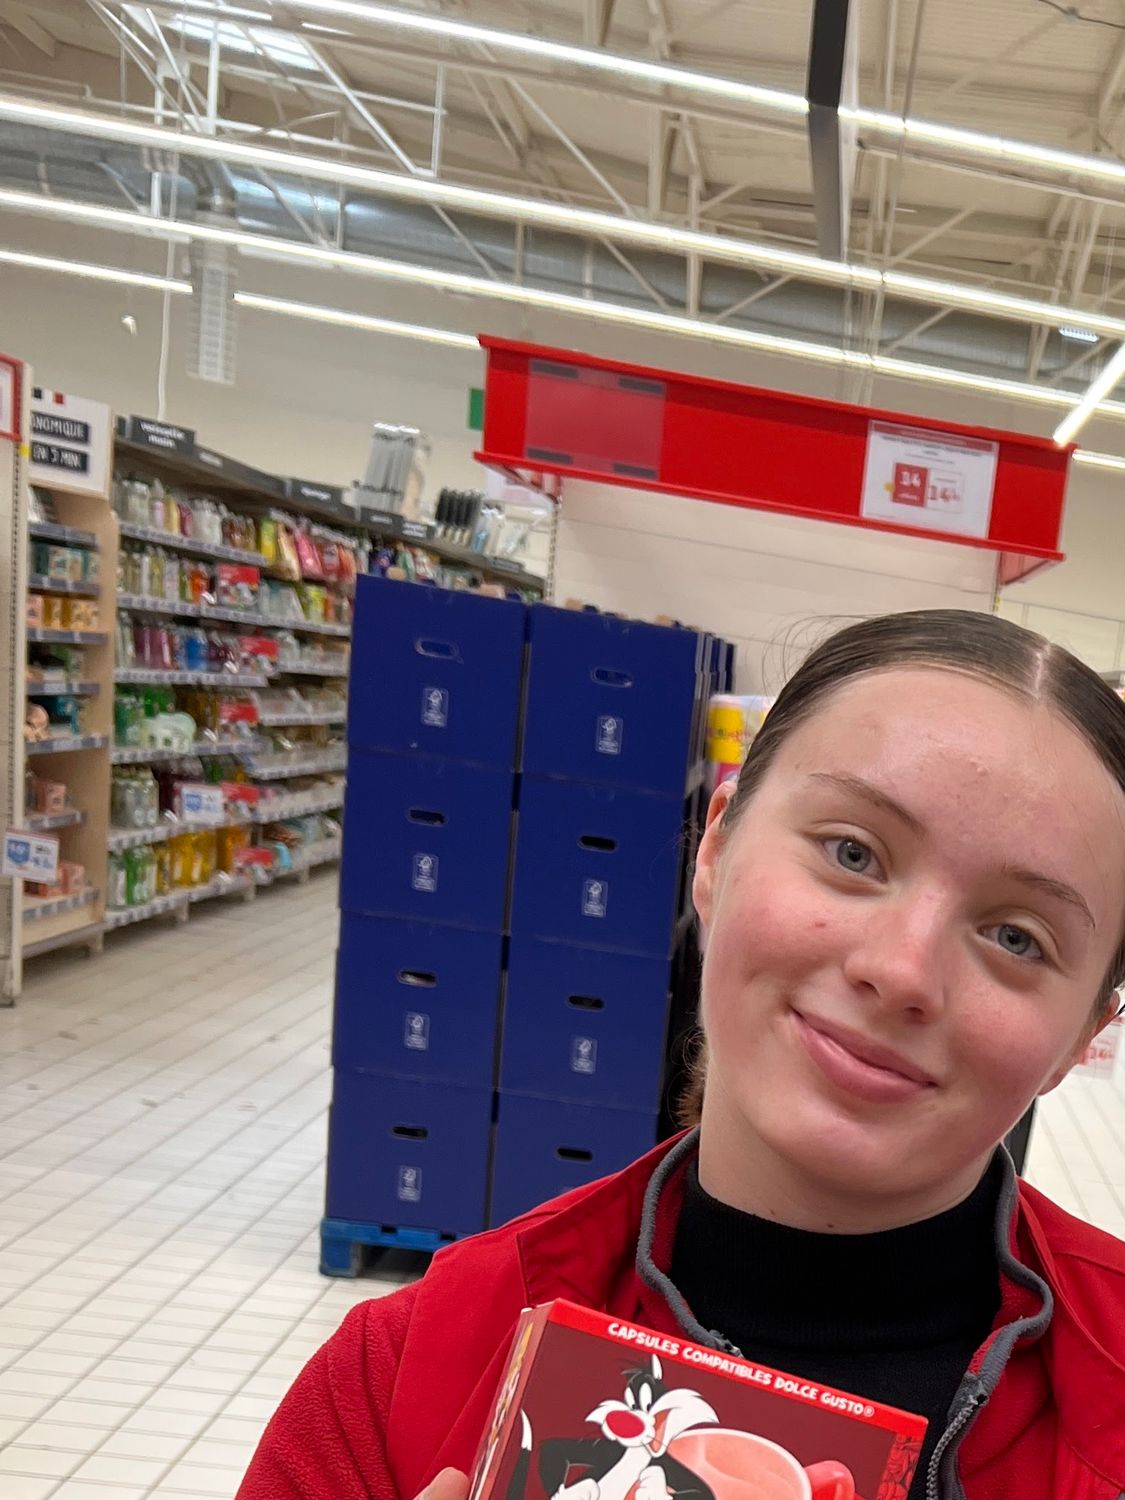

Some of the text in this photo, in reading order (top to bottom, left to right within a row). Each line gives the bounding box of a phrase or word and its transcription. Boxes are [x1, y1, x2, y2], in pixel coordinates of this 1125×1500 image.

[607, 1323, 679, 1355] CAPSULES
[682, 1346, 772, 1386] COMPATIBLES
[773, 1373, 818, 1400] DOLCE
